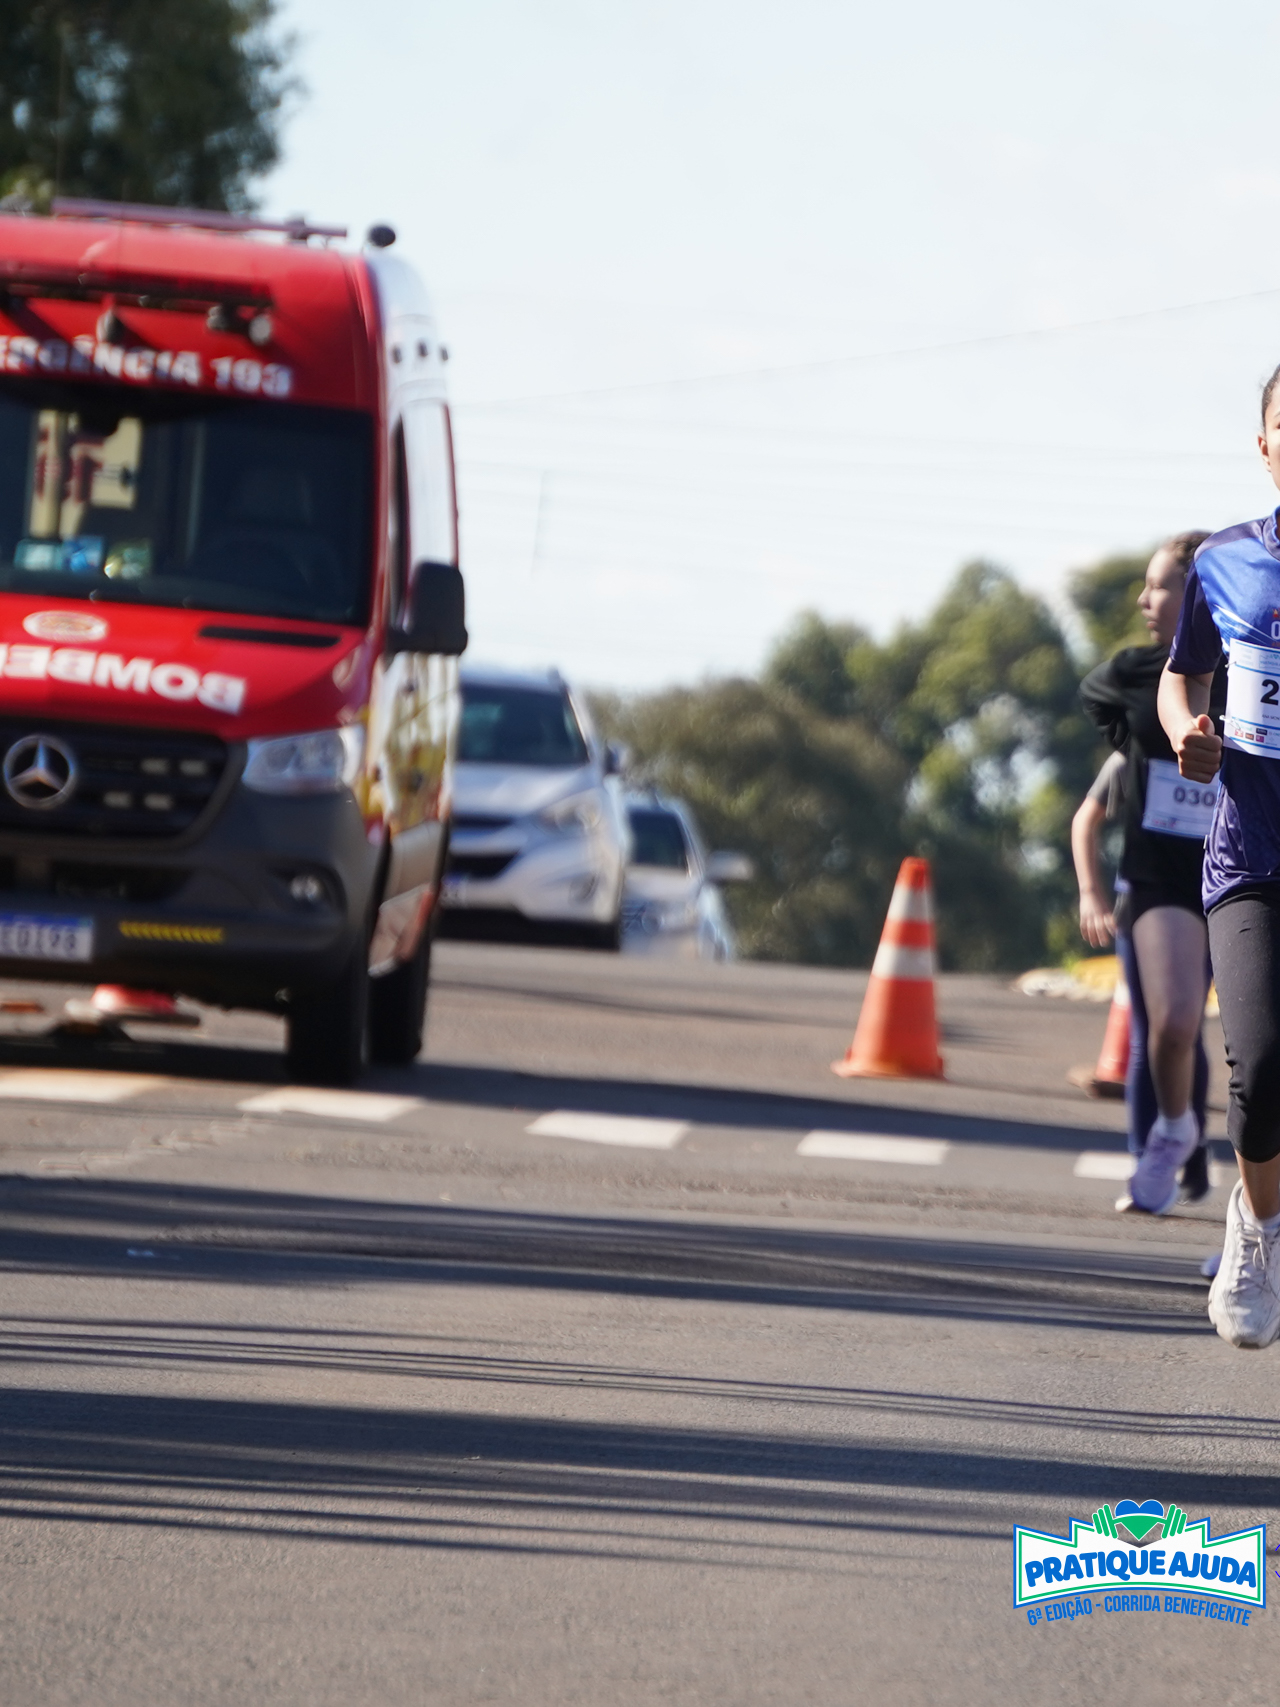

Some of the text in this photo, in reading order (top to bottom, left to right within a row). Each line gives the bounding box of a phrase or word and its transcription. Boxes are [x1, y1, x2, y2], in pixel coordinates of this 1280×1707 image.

[0, 334, 291, 397] RGÊNCIA 193
[1174, 786, 1215, 807] 030
